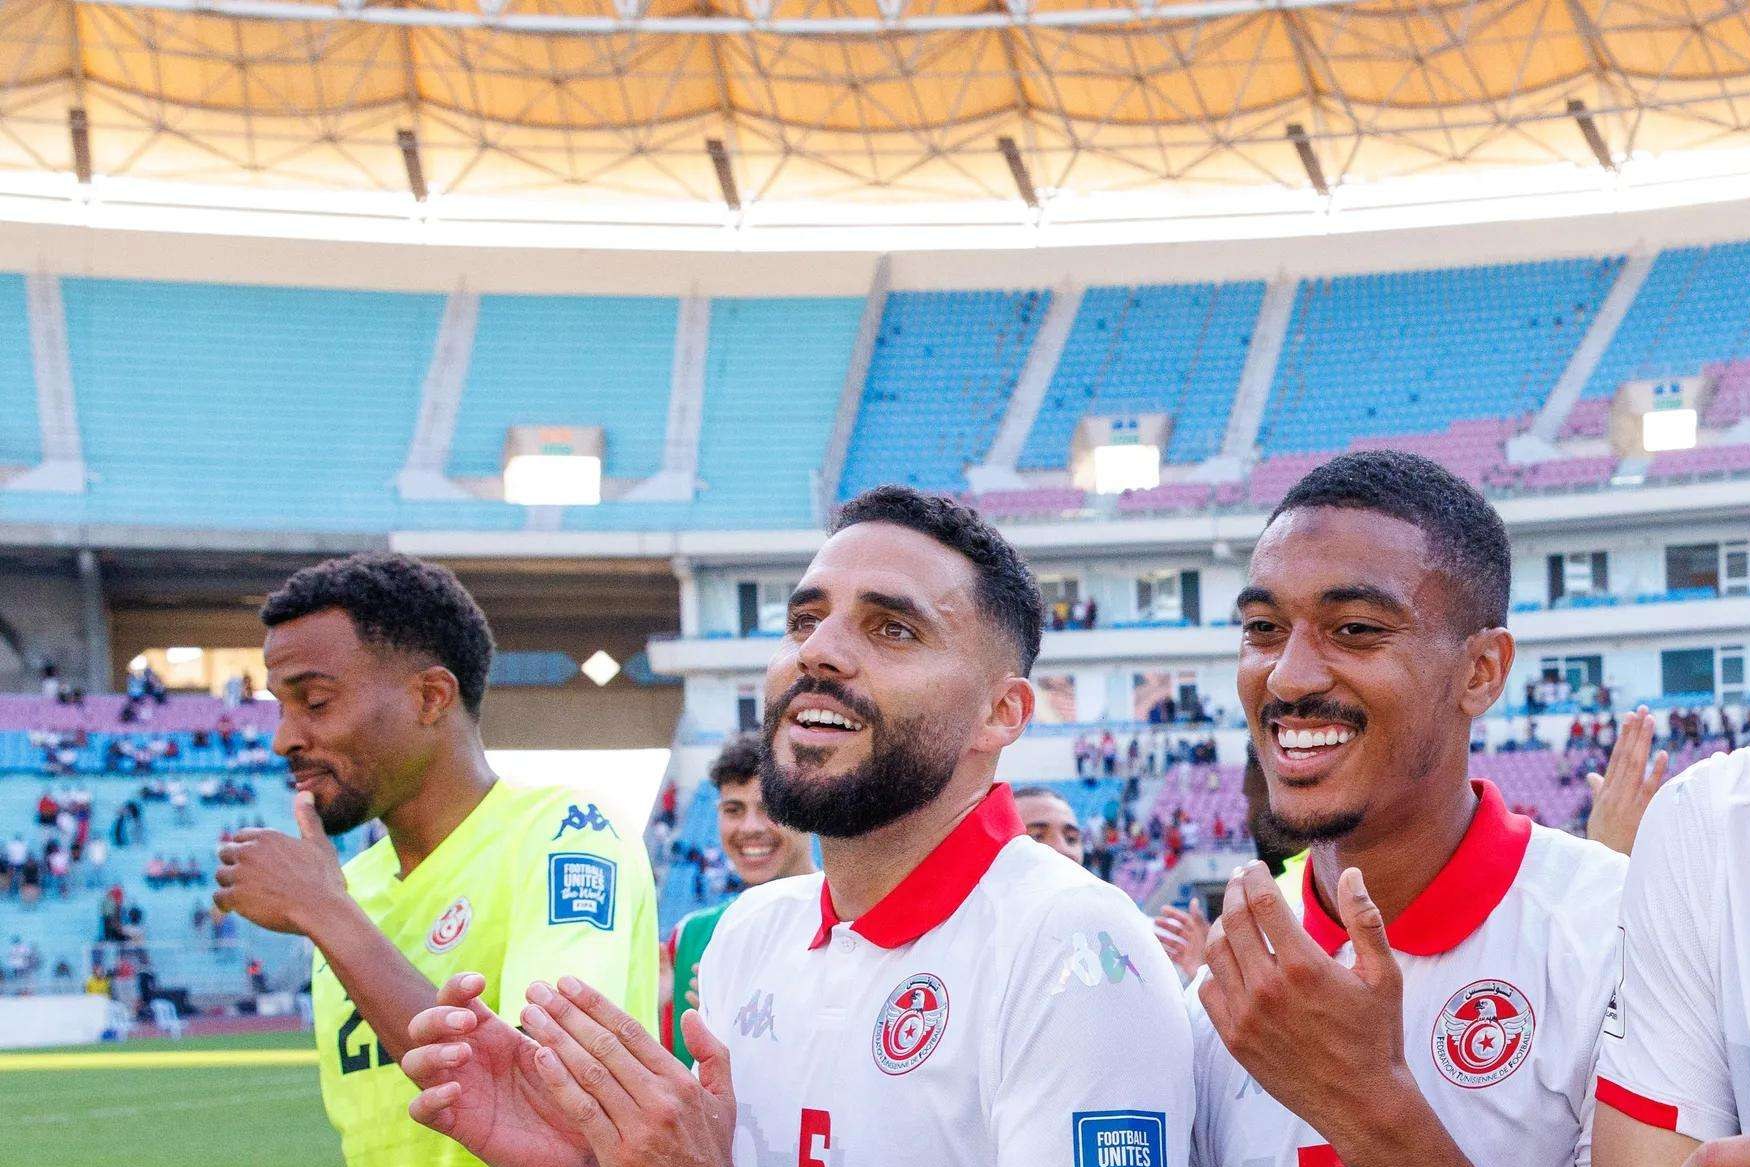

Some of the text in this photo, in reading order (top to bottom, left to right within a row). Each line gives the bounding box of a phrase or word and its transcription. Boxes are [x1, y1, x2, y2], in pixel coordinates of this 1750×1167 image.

[1499, 1067, 1509, 1076] DE
[1097, 1130, 1149, 1146] FOOTBALL
[1098, 1146, 1151, 1167] UNITES
